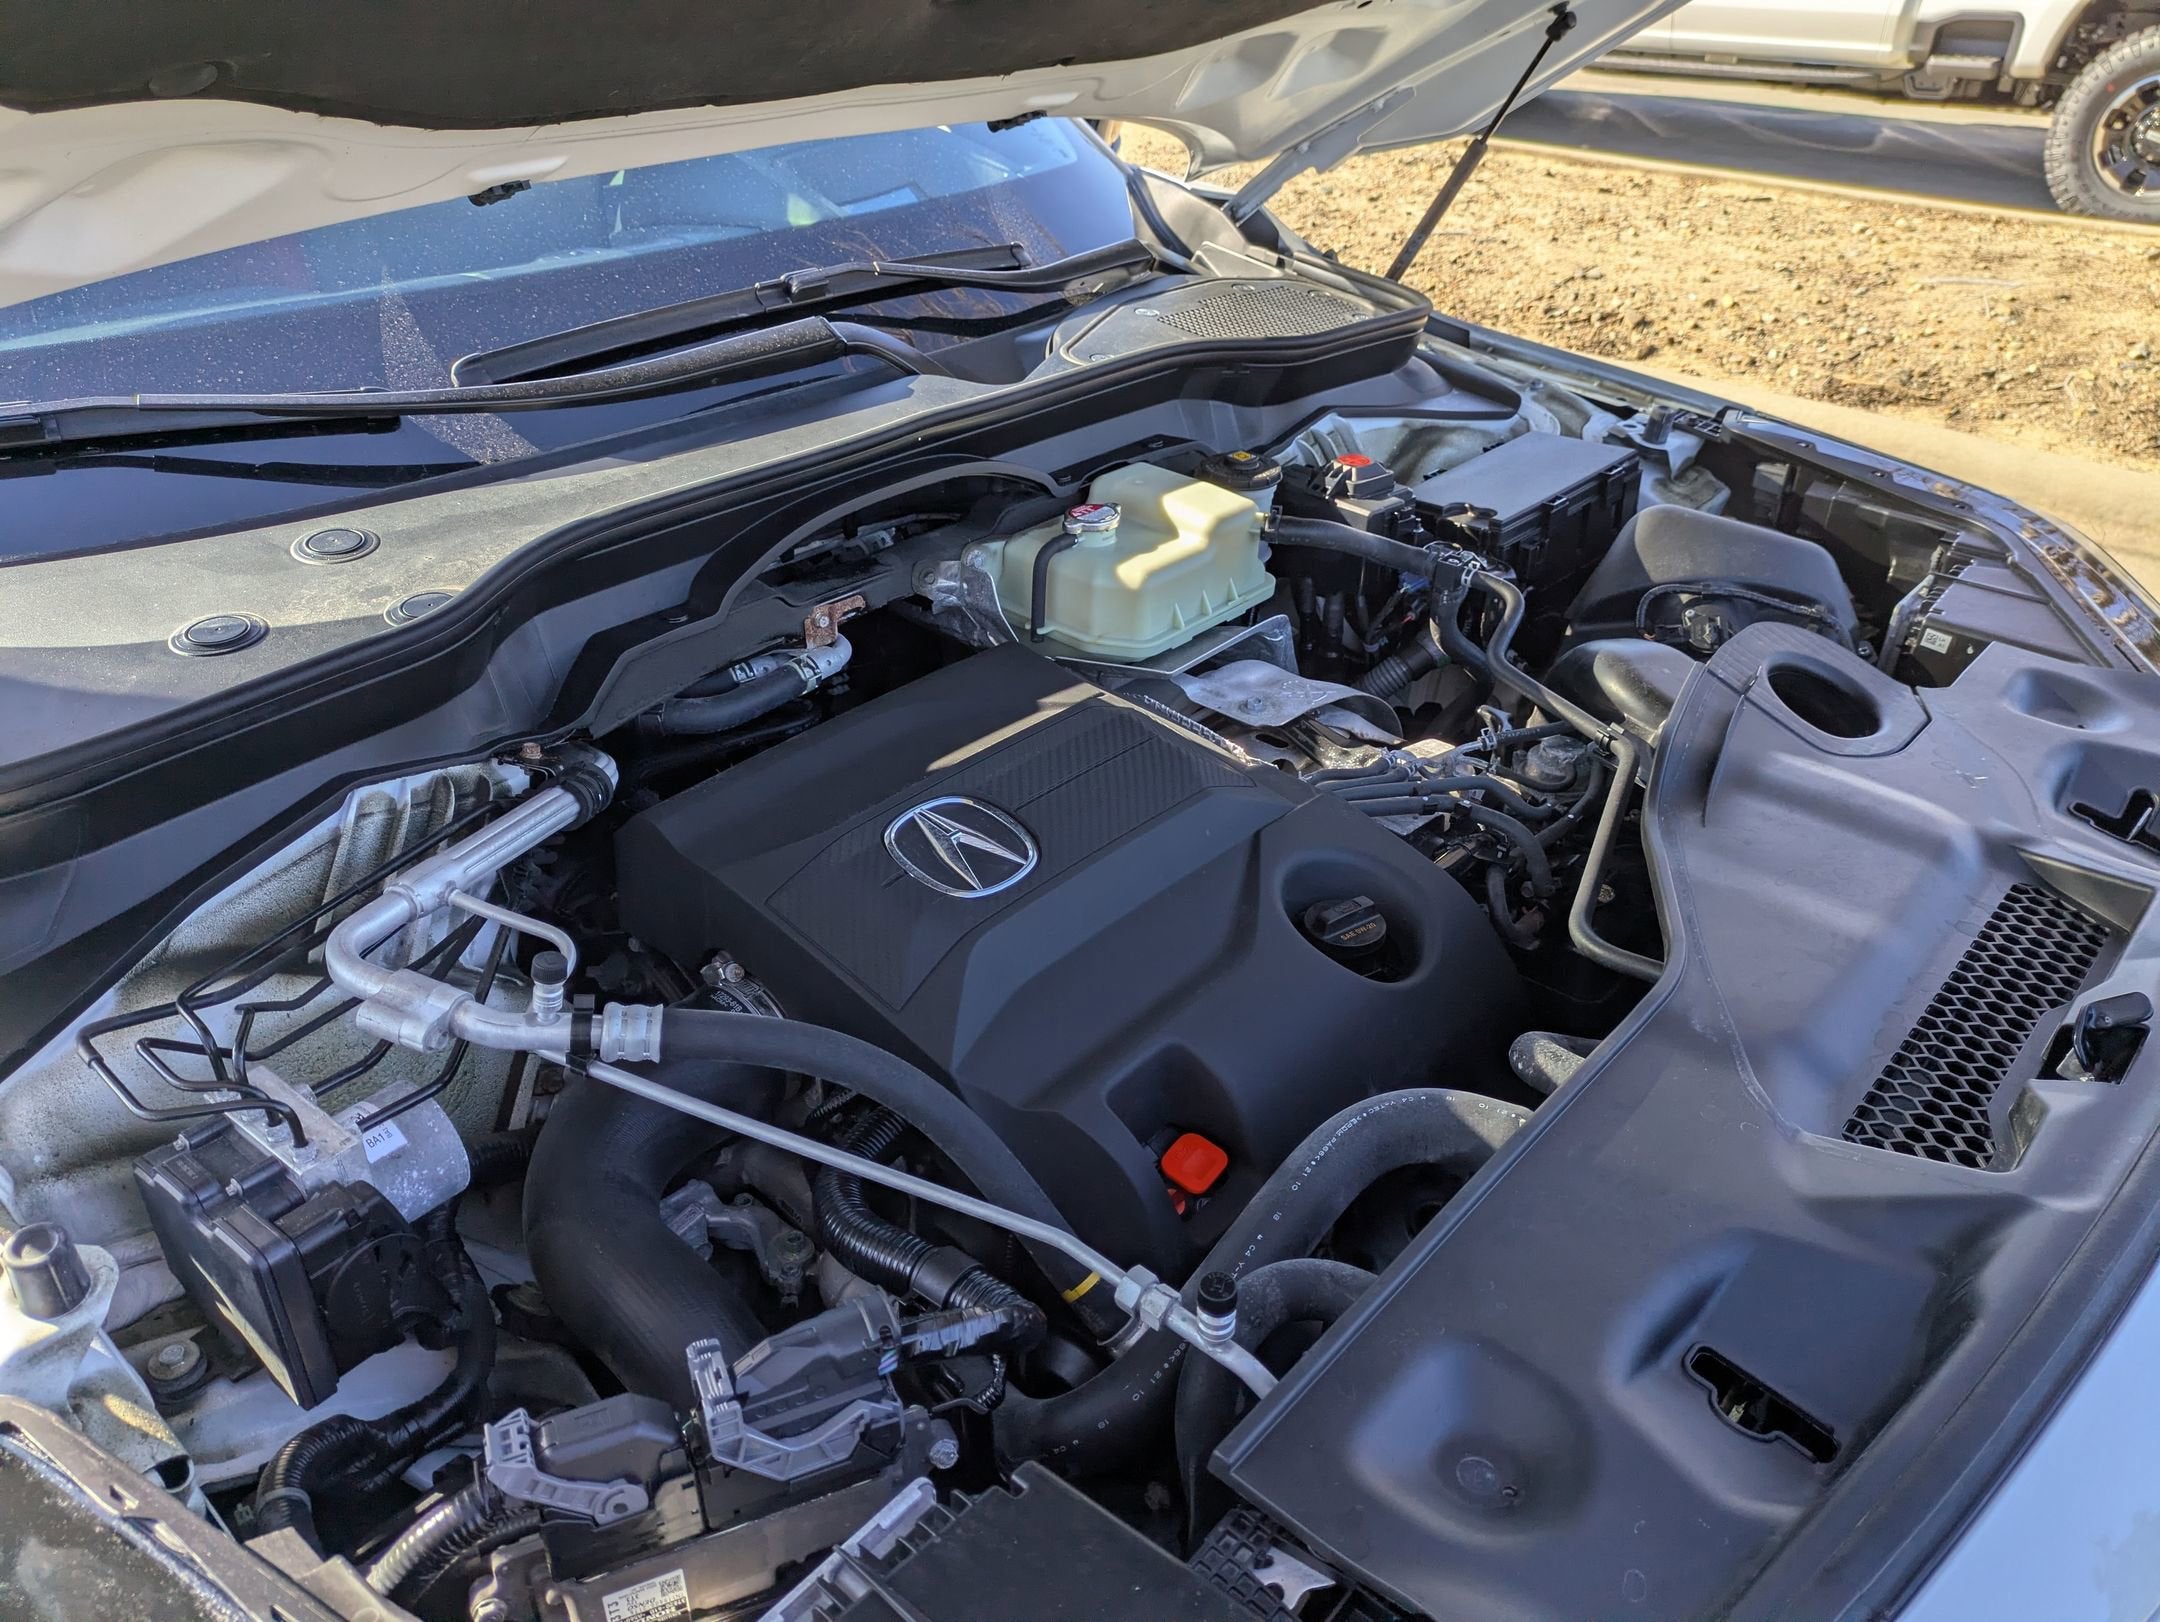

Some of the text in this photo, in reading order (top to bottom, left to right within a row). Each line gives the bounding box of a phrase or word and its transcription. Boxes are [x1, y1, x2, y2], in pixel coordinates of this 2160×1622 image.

[365, 1132, 386, 1149] BA1
[1291, 1181, 1302, 1191] 10
[1245, 1244, 1257, 1257] C4
[1132, 1390, 1145, 1401] 10
